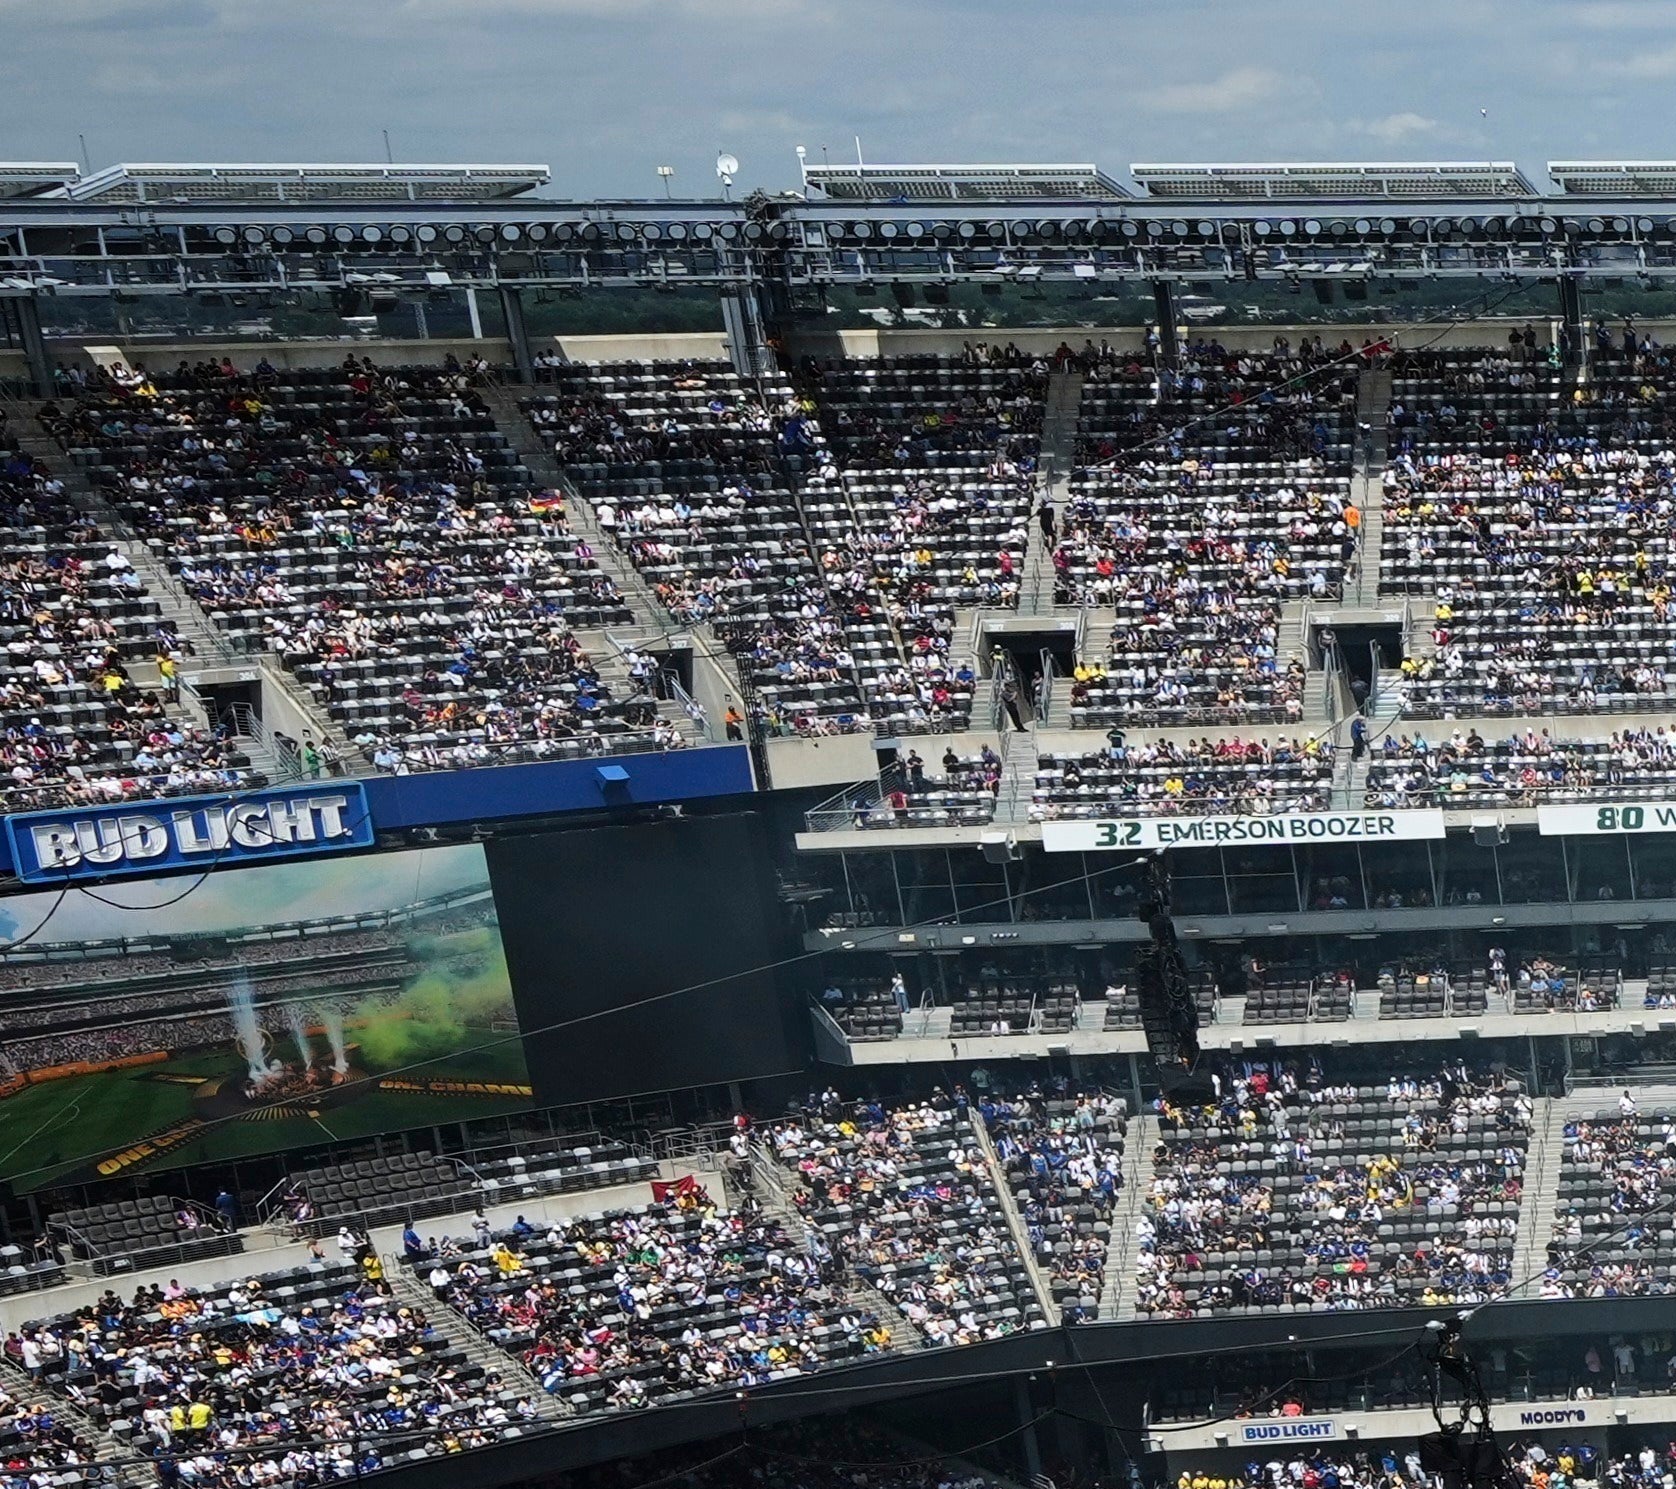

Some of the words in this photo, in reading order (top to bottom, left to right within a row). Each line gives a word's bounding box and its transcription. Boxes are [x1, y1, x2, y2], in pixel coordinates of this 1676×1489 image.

[1094, 822, 1143, 847] 32
[1156, 818, 1287, 843] EMERSON
[1291, 815, 1397, 840] BOOZER
[1596, 805, 1645, 831] 80
[30, 814, 168, 870] BUD
[97, 1143, 157, 1175] ONE
[1245, 1425, 1282, 1441] BUD
[1284, 1422, 1332, 1439] LIGHT
[1520, 1409, 1586, 1426] MOODY'S
